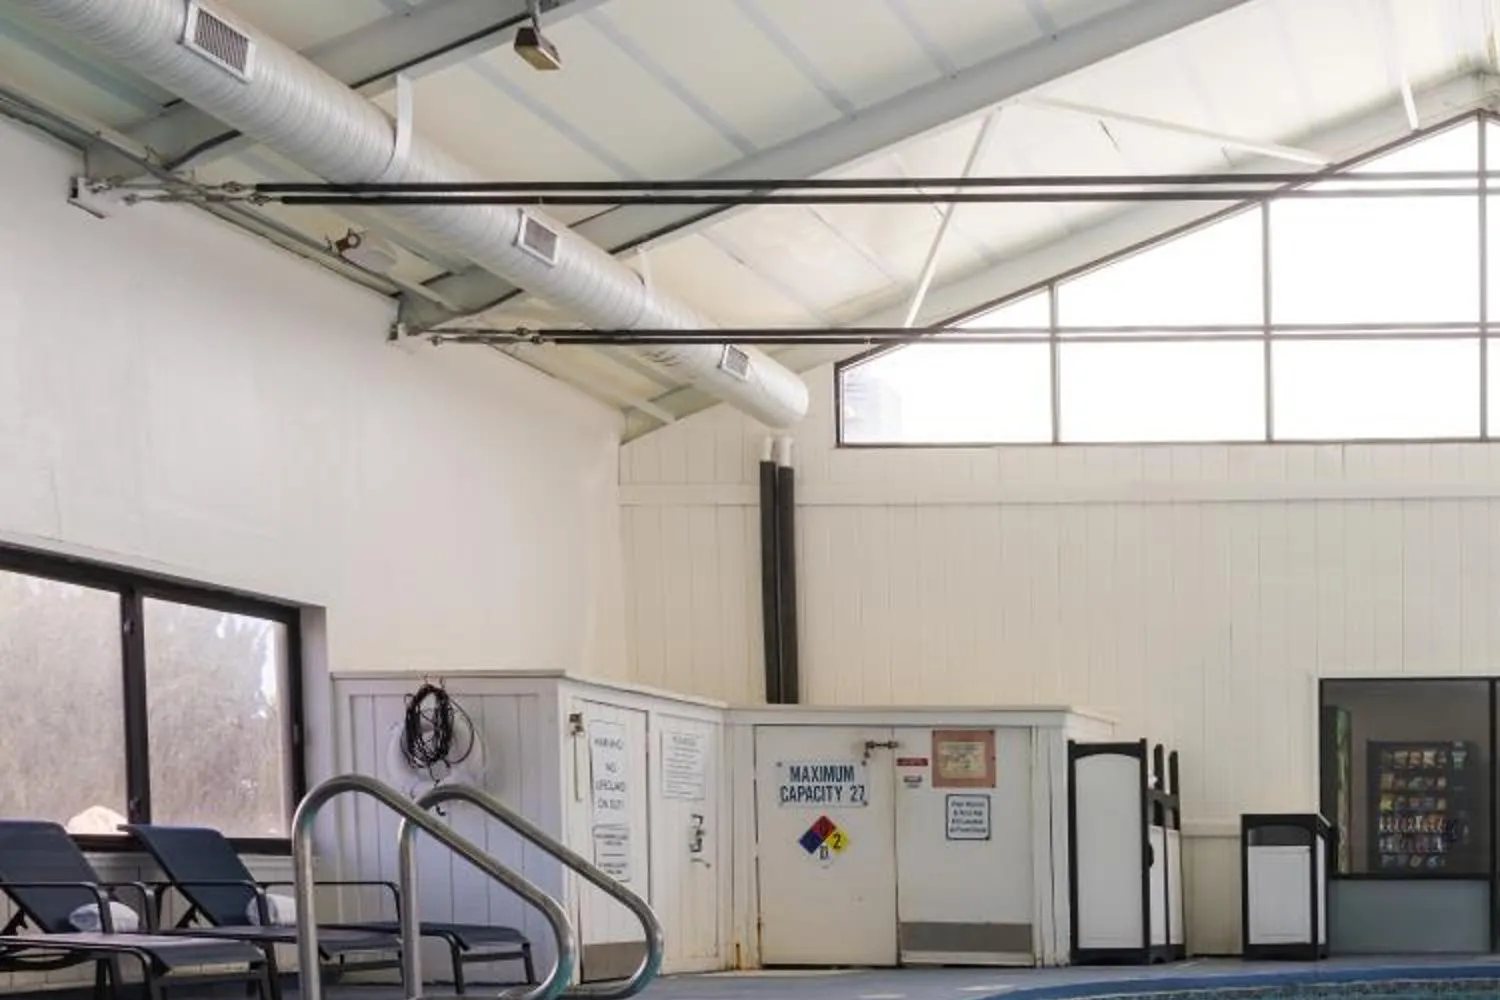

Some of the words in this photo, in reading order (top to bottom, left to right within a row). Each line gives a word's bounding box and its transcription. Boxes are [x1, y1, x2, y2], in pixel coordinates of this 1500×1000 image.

[790, 765, 854, 782] MAXIMUM
[780, 785, 843, 802] CAPACITY
[849, 785, 865, 802] 27
[833, 832, 842, 849] 2
